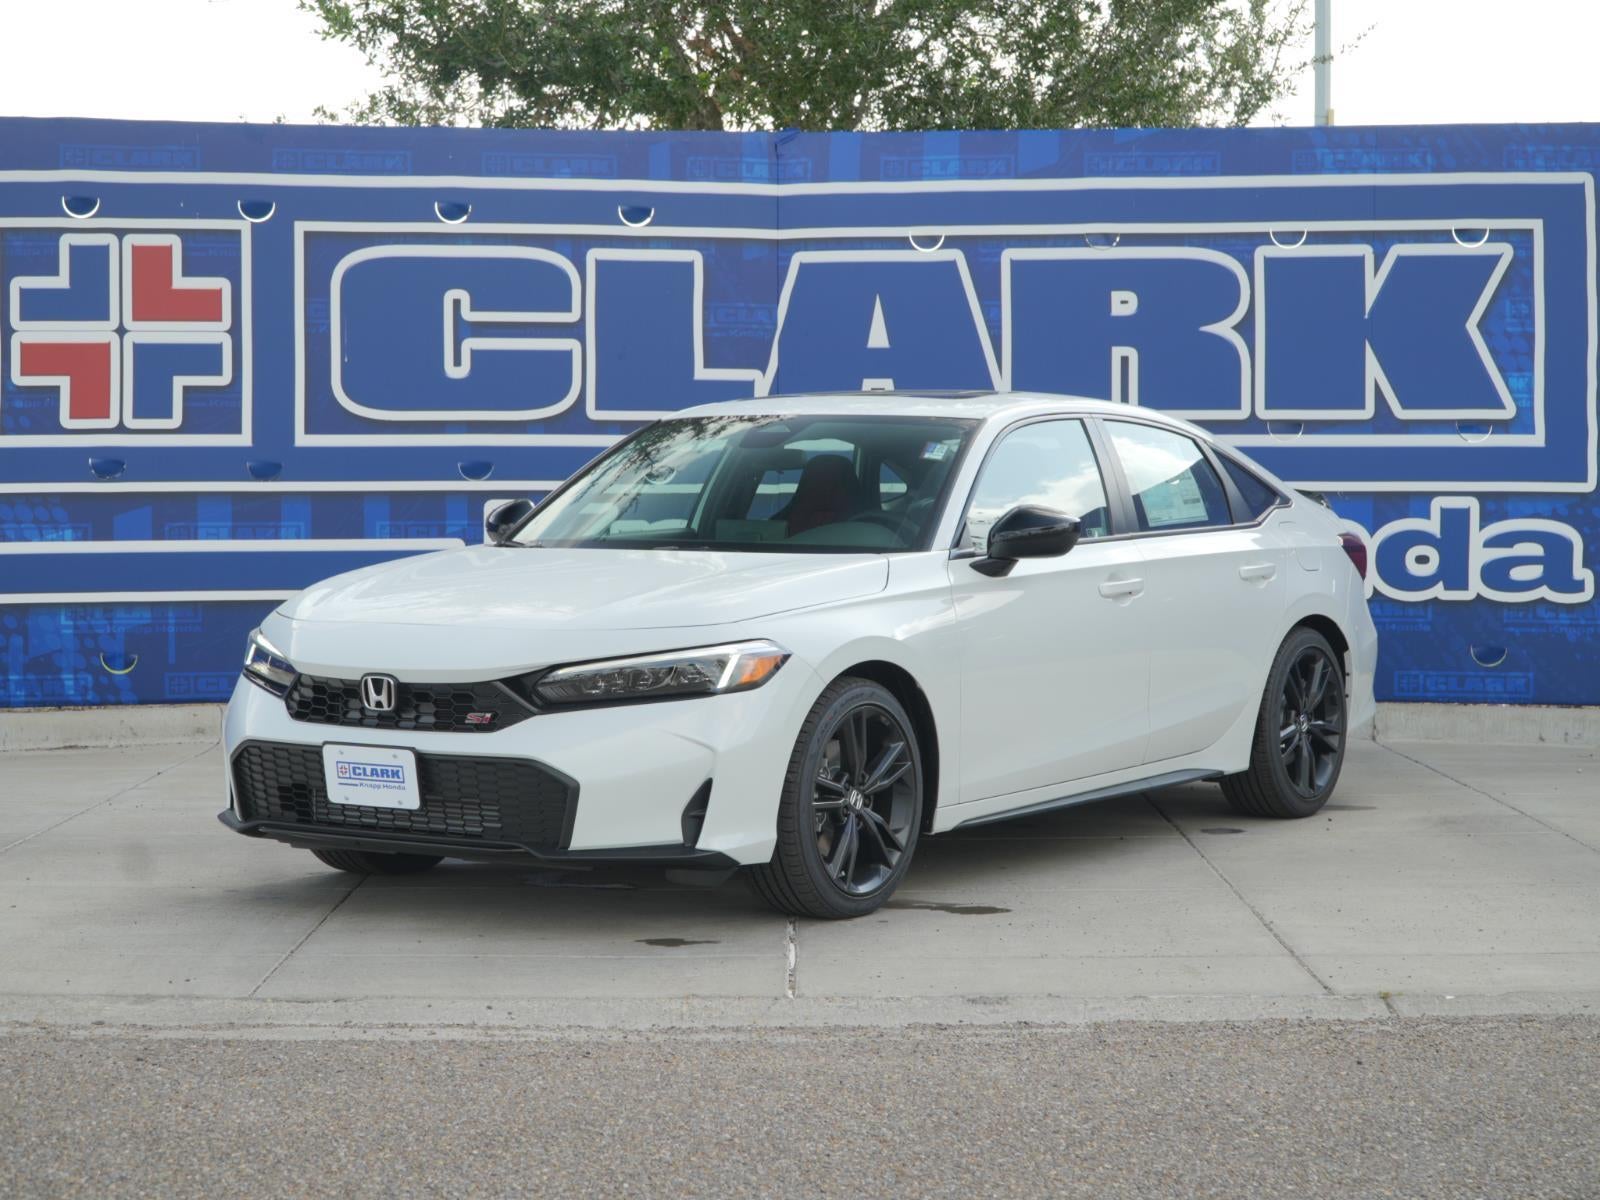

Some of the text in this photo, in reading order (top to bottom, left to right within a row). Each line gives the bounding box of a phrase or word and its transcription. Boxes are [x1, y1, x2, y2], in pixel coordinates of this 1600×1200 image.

[330, 243, 1517, 422] CLARK
[1340, 496, 1594, 604] da
[351, 766, 401, 780] CLARK
[360, 782, 381, 791] Knapp
